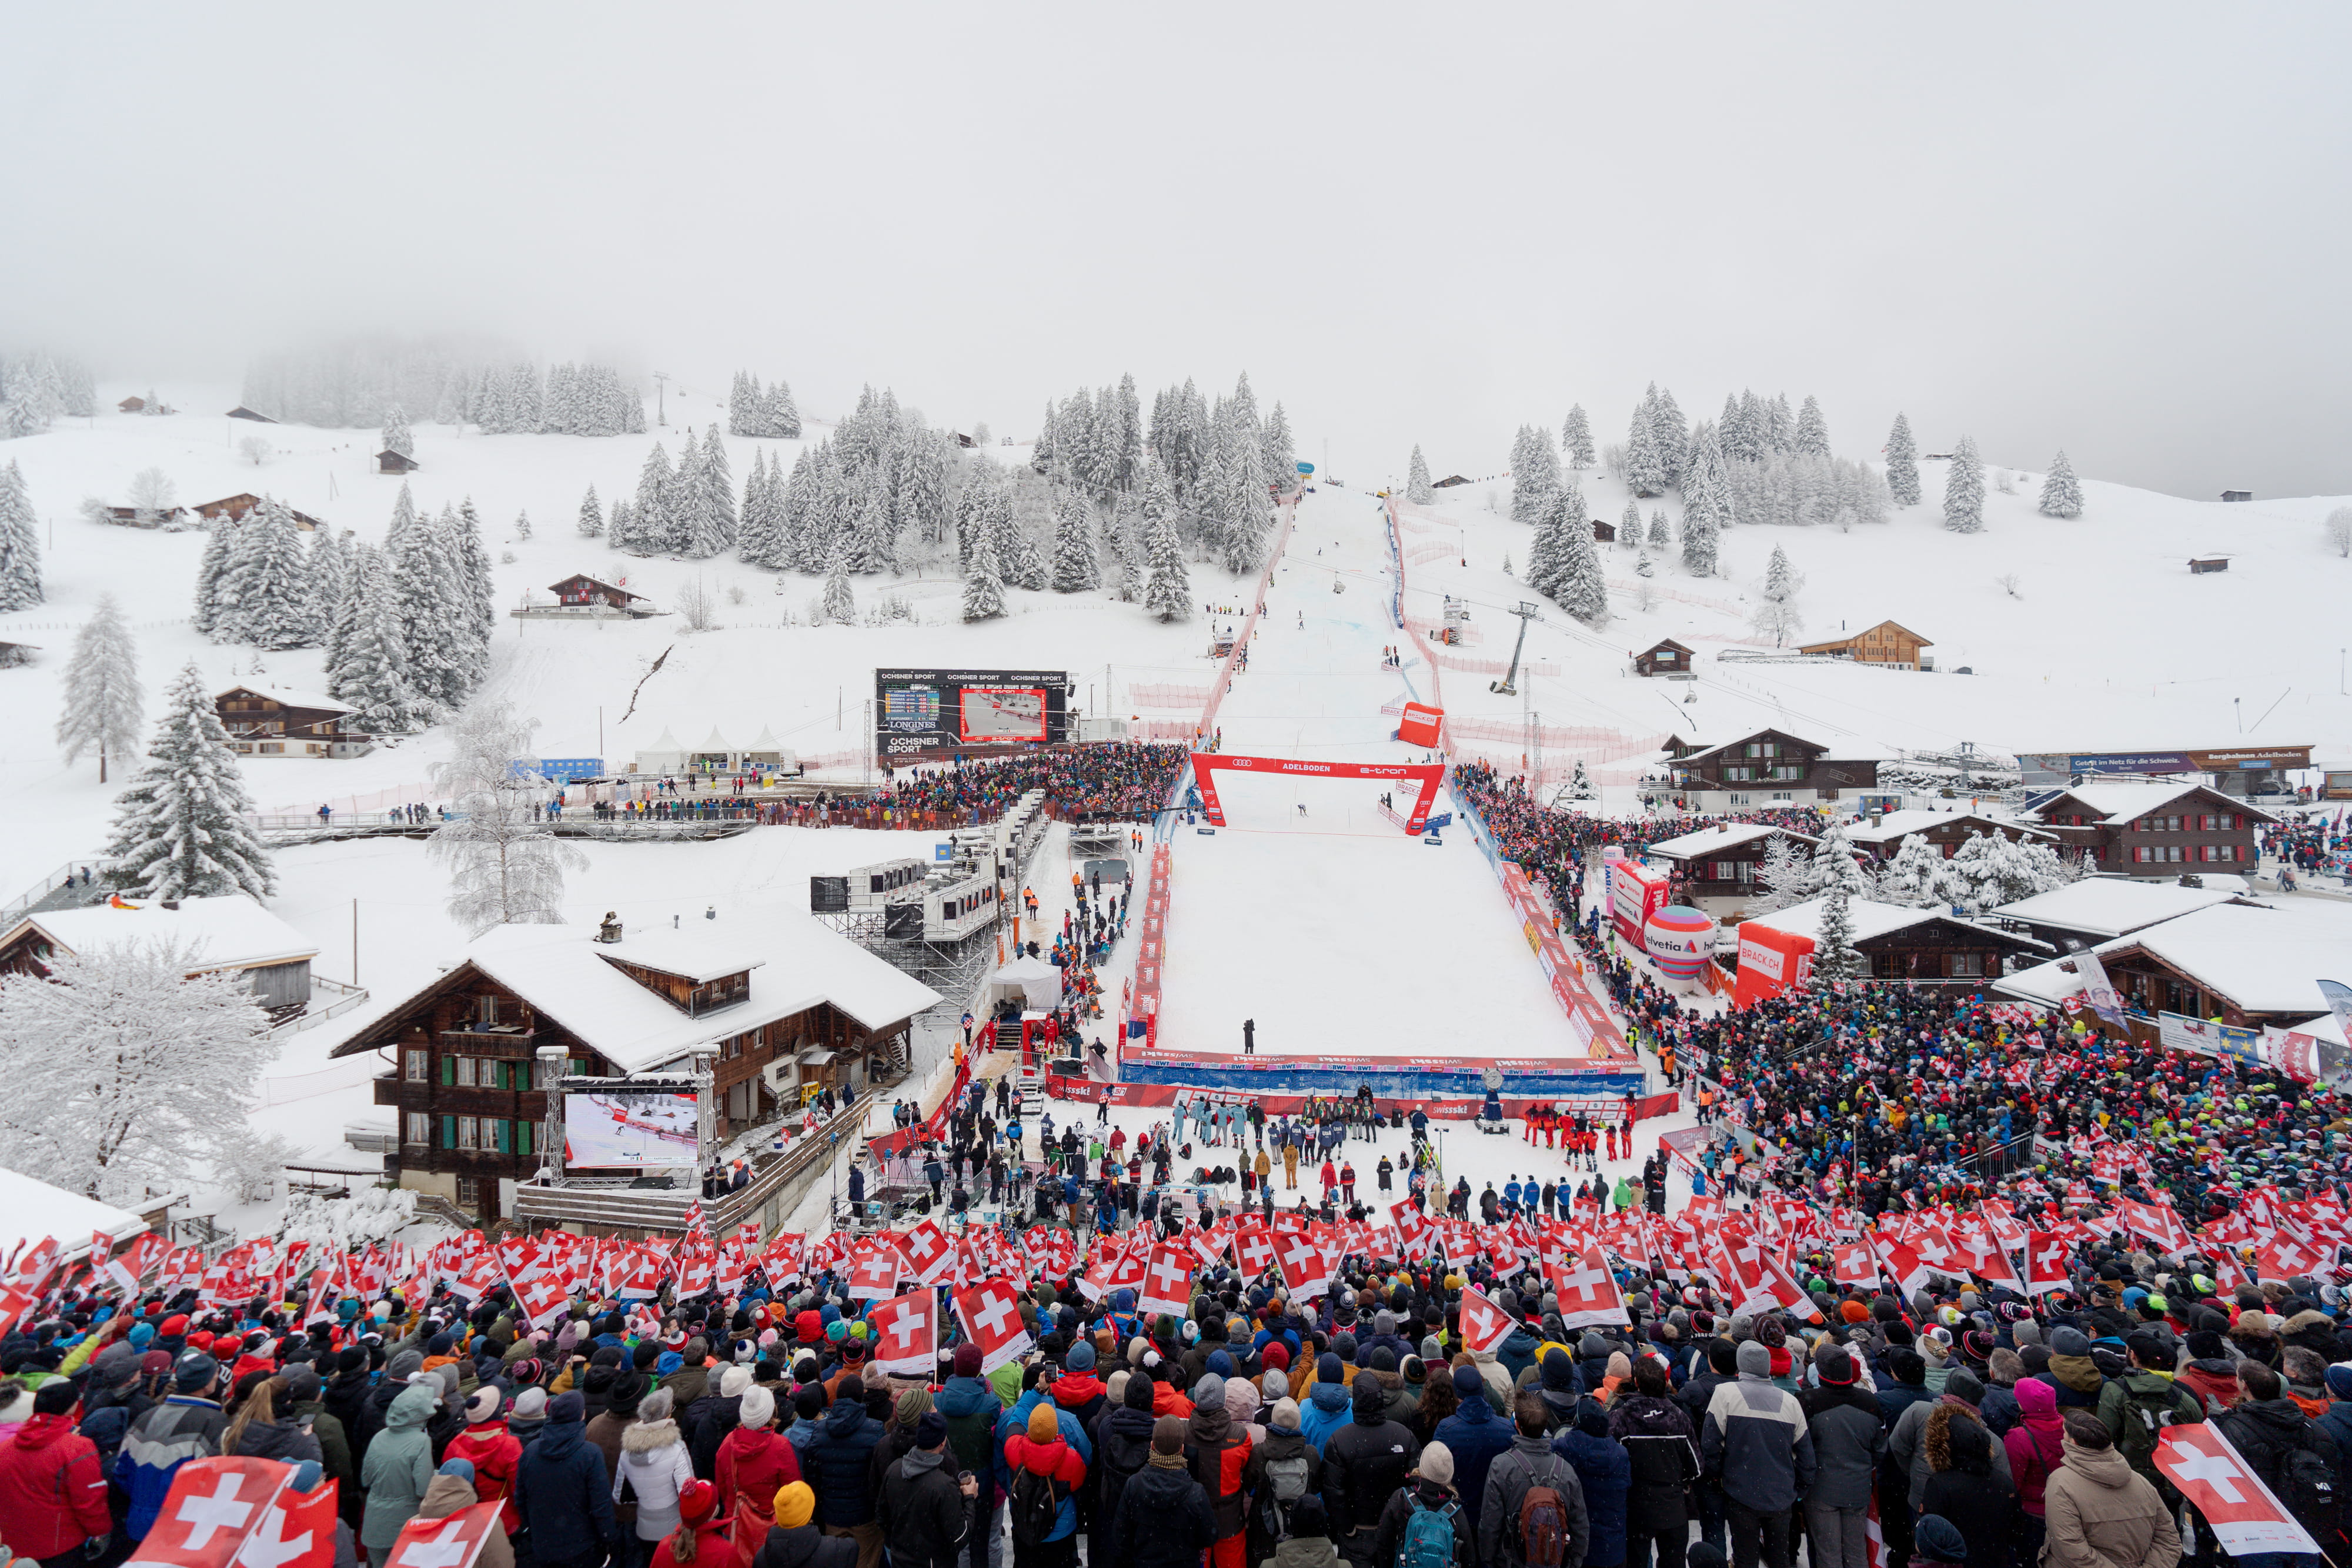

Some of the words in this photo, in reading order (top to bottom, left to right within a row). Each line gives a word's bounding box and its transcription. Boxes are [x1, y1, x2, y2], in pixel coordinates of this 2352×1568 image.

[1408, 713, 1435, 723] BRACK.CH
[1282, 763, 1330, 772] ADELBODEN
[1398, 783, 1421, 795] BRACK.C
[1626, 884, 1640, 896] Sunrise
[1616, 898, 1633, 916] helvetia
[1653, 889, 1664, 911] sski
[1742, 948, 1779, 971] BRACK.CH
[1141, 994, 1151, 1013] swissski
[1603, 1033, 1628, 1055] swissski
[1433, 1105, 1468, 1114] swissski
